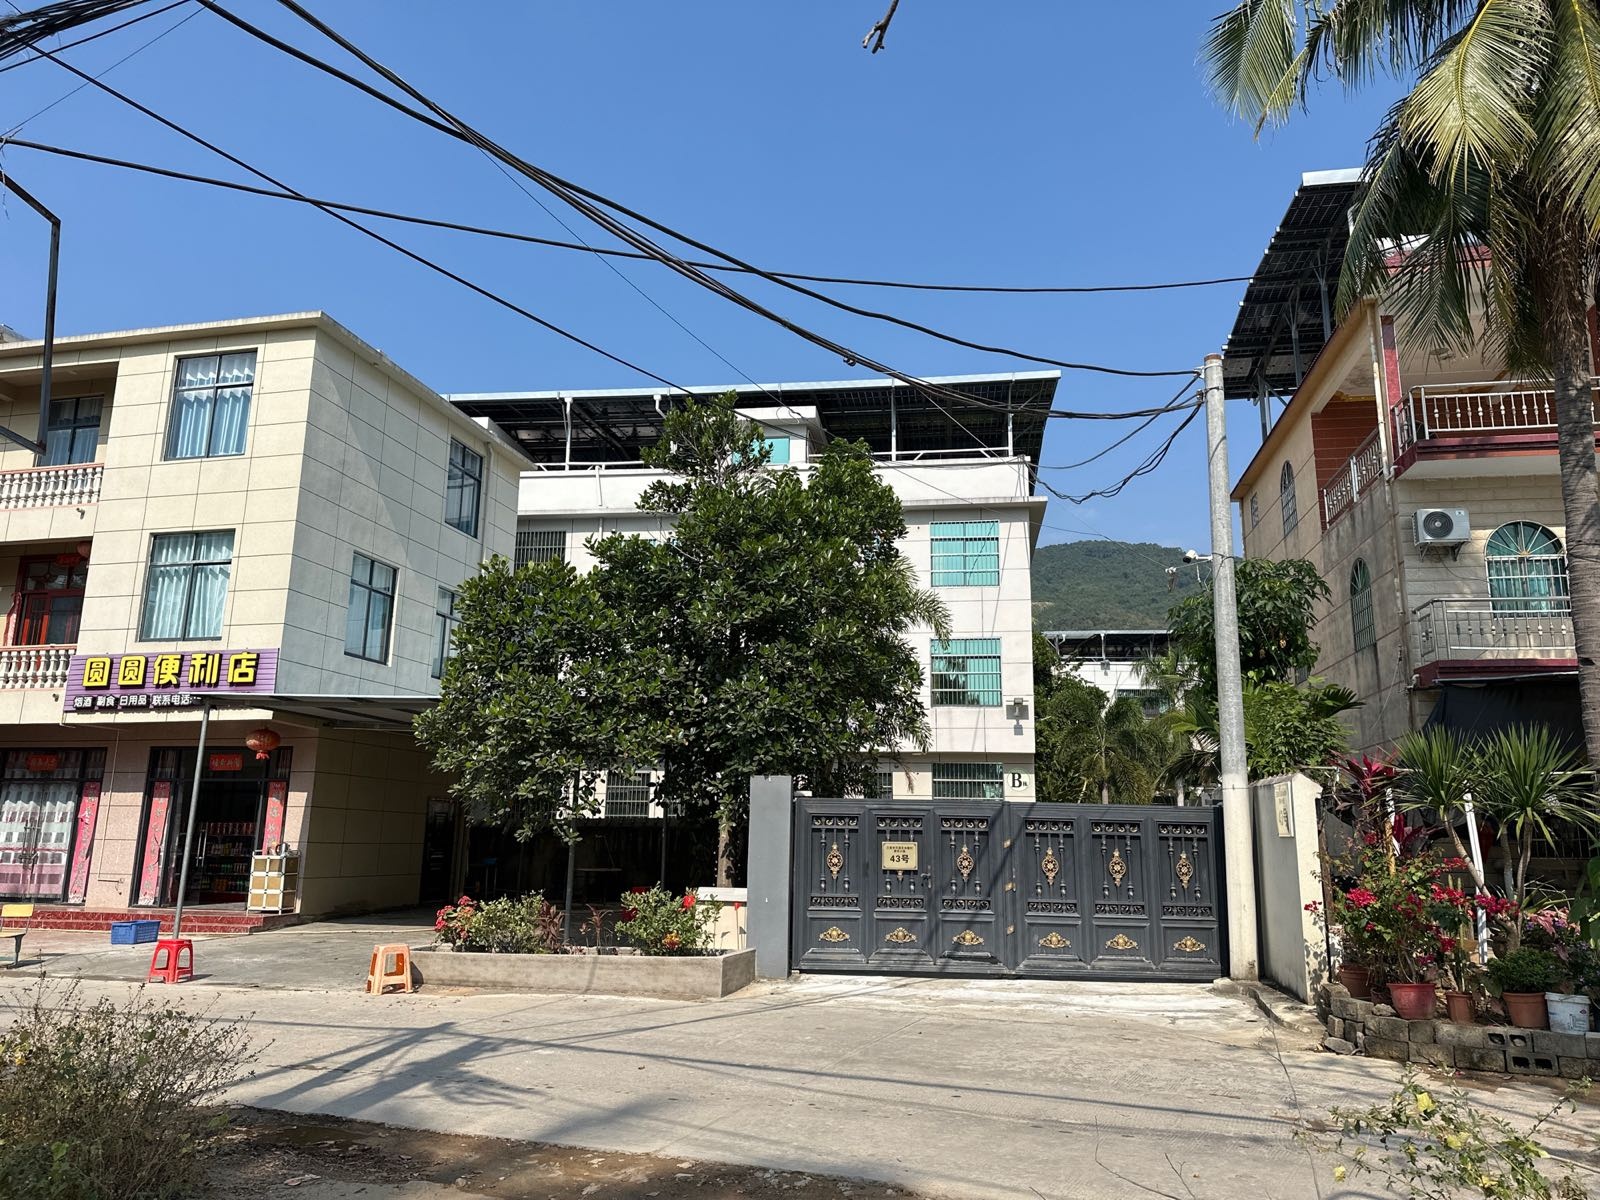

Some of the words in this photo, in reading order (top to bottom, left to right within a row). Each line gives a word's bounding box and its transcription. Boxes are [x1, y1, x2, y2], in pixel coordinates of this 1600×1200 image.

[82, 652, 258, 687] 圆圆便利店
[74, 696, 92, 707] 烟酒
[97, 694, 115, 707] 副食
[119, 693, 147, 706] 日用品
[889, 854, 910, 863] 43号
